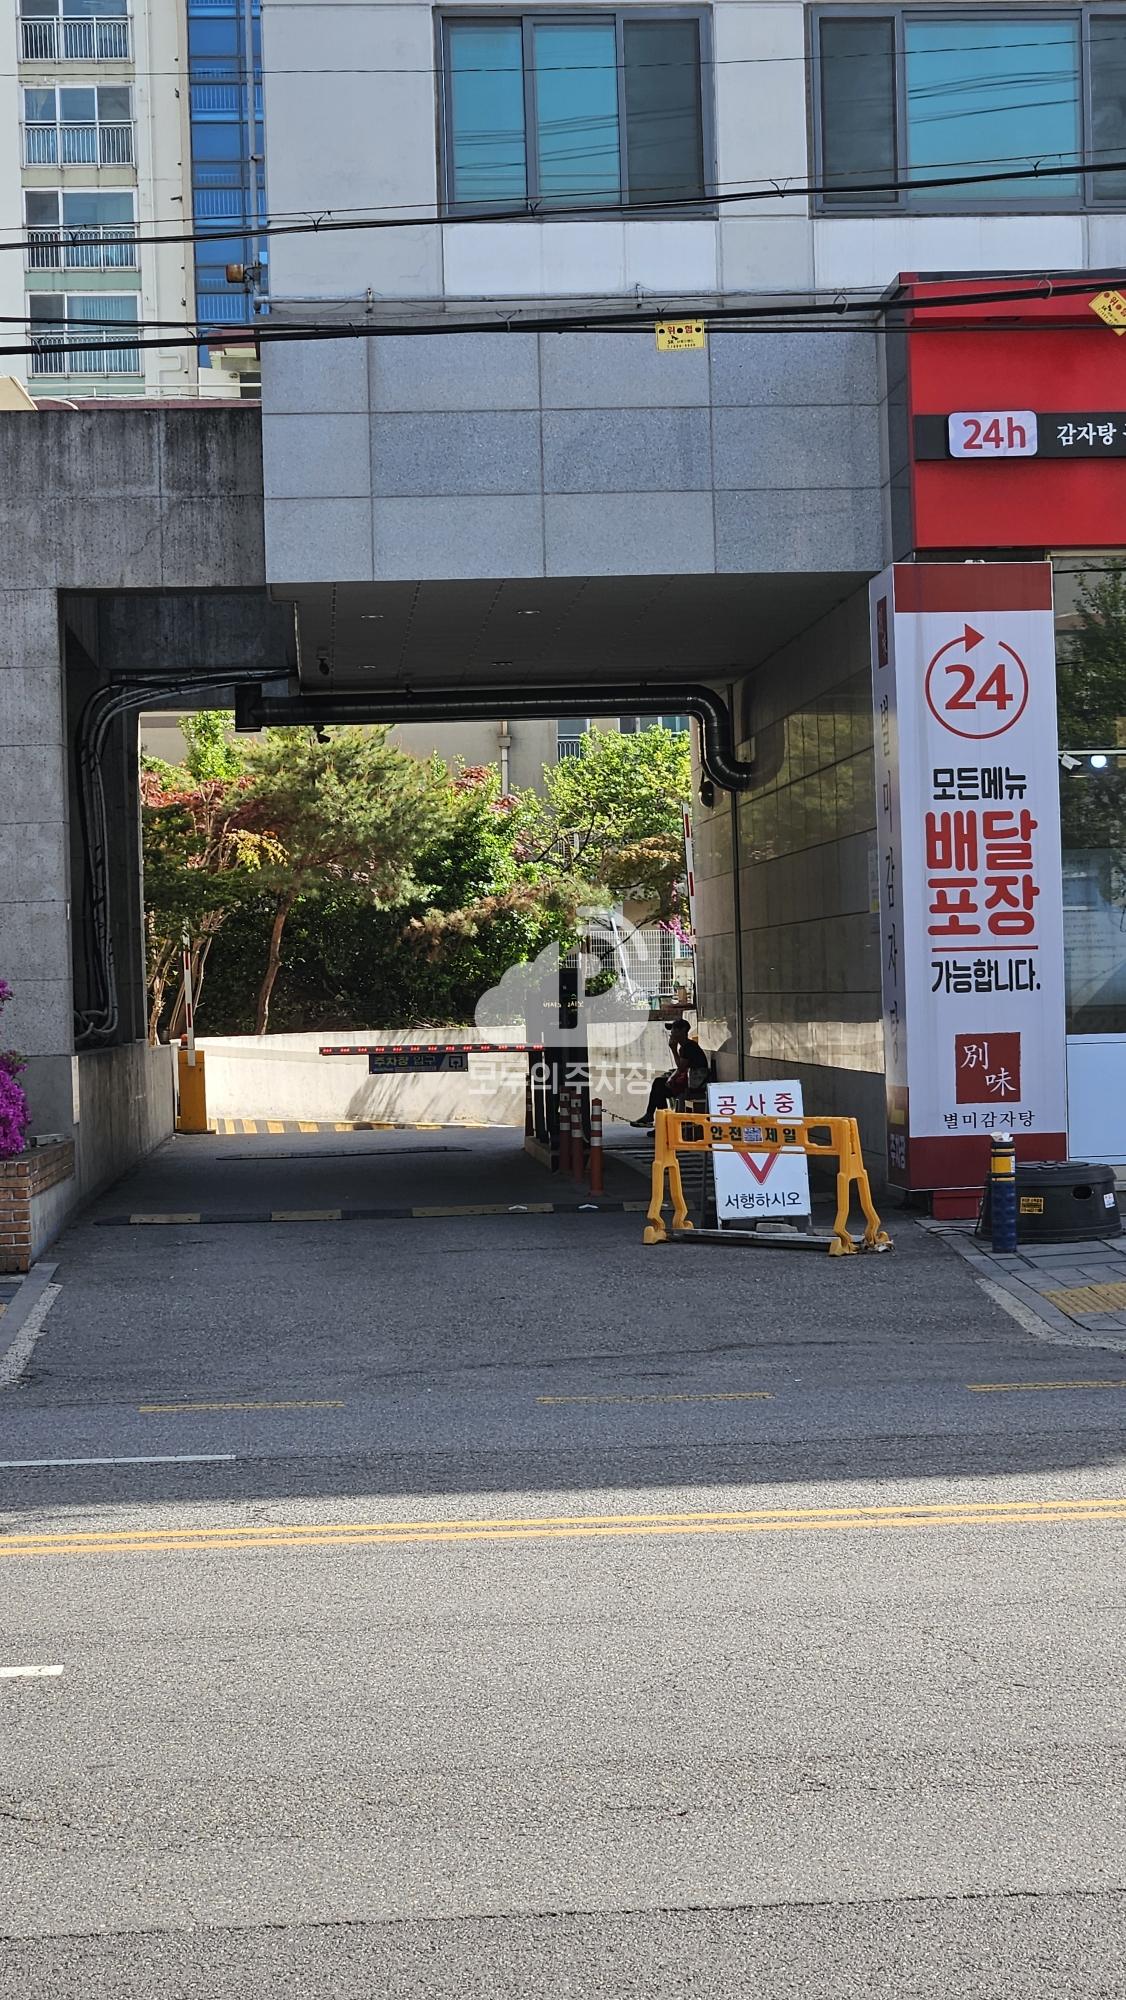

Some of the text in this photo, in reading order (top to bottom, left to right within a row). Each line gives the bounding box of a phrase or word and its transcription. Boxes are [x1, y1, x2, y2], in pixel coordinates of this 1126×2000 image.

[962, 416, 1027, 450] 24h
[1057, 422, 1117, 447] 감자탕
[945, 663, 1014, 710] 24
[932, 766, 1027, 800] 모든메뉴
[925, 808, 1038, 871] 배달
[927, 873, 1041, 936] 포장
[930, 957, 1041, 994] 가능합니다.
[374, 1055, 436, 1067] 주차장 입구
[943, 1110, 1036, 1130] 별미감자탕
[724, 1191, 803, 1210] 서행하시오
